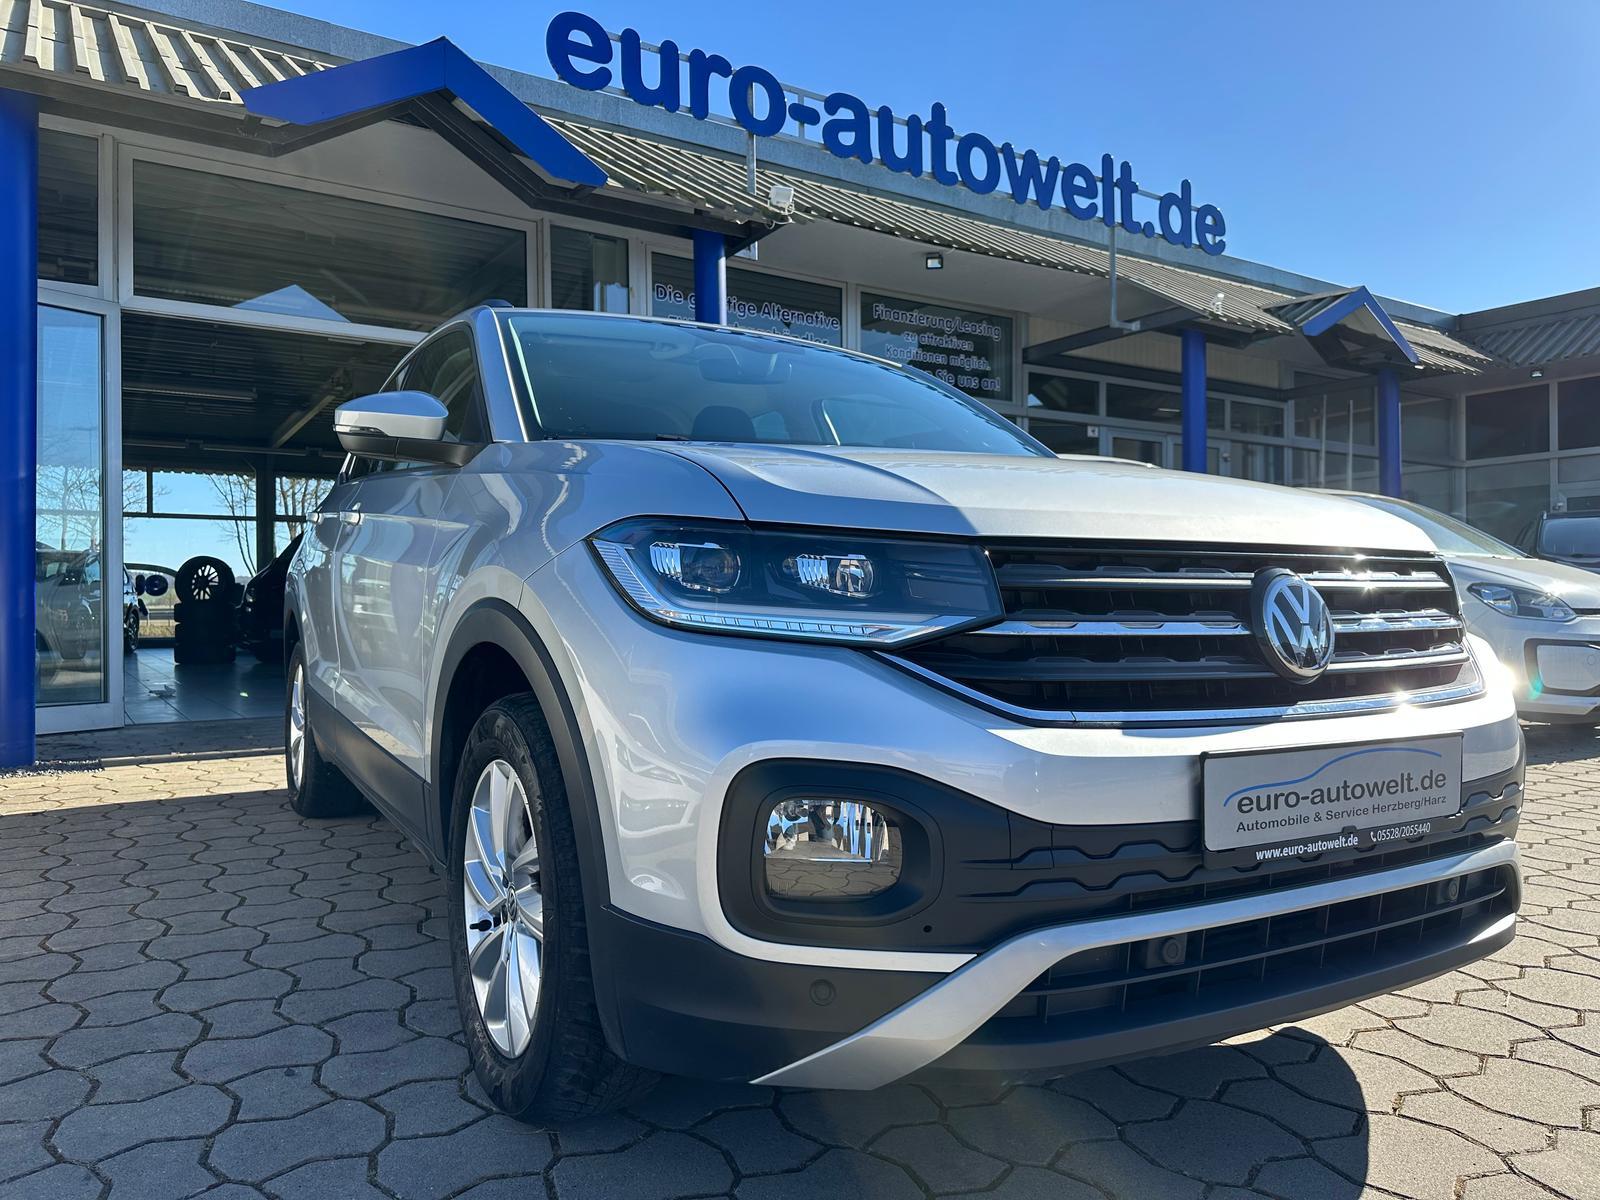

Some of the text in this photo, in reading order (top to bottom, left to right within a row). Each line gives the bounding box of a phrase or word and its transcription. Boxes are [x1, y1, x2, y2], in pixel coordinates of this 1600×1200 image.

[546, 11, 1226, 255] euro-autowelt.de
[655, 284, 840, 330] Die gtige Alternative
[873, 303, 1001, 341] Finanzierung/Leasing
[885, 344, 947, 364] Konditionen
[904, 331, 974, 351] zu attraktiven
[957, 375, 979, 390] uns
[981, 377, 1001, 392] an!
[1237, 769, 1447, 814] euro-autowelt.de
[1236, 795, 1447, 833] Automobile & Service Herzberg/Harz
[1255, 822, 1431, 861] www.euro-autowelt.de 05528/2055440
